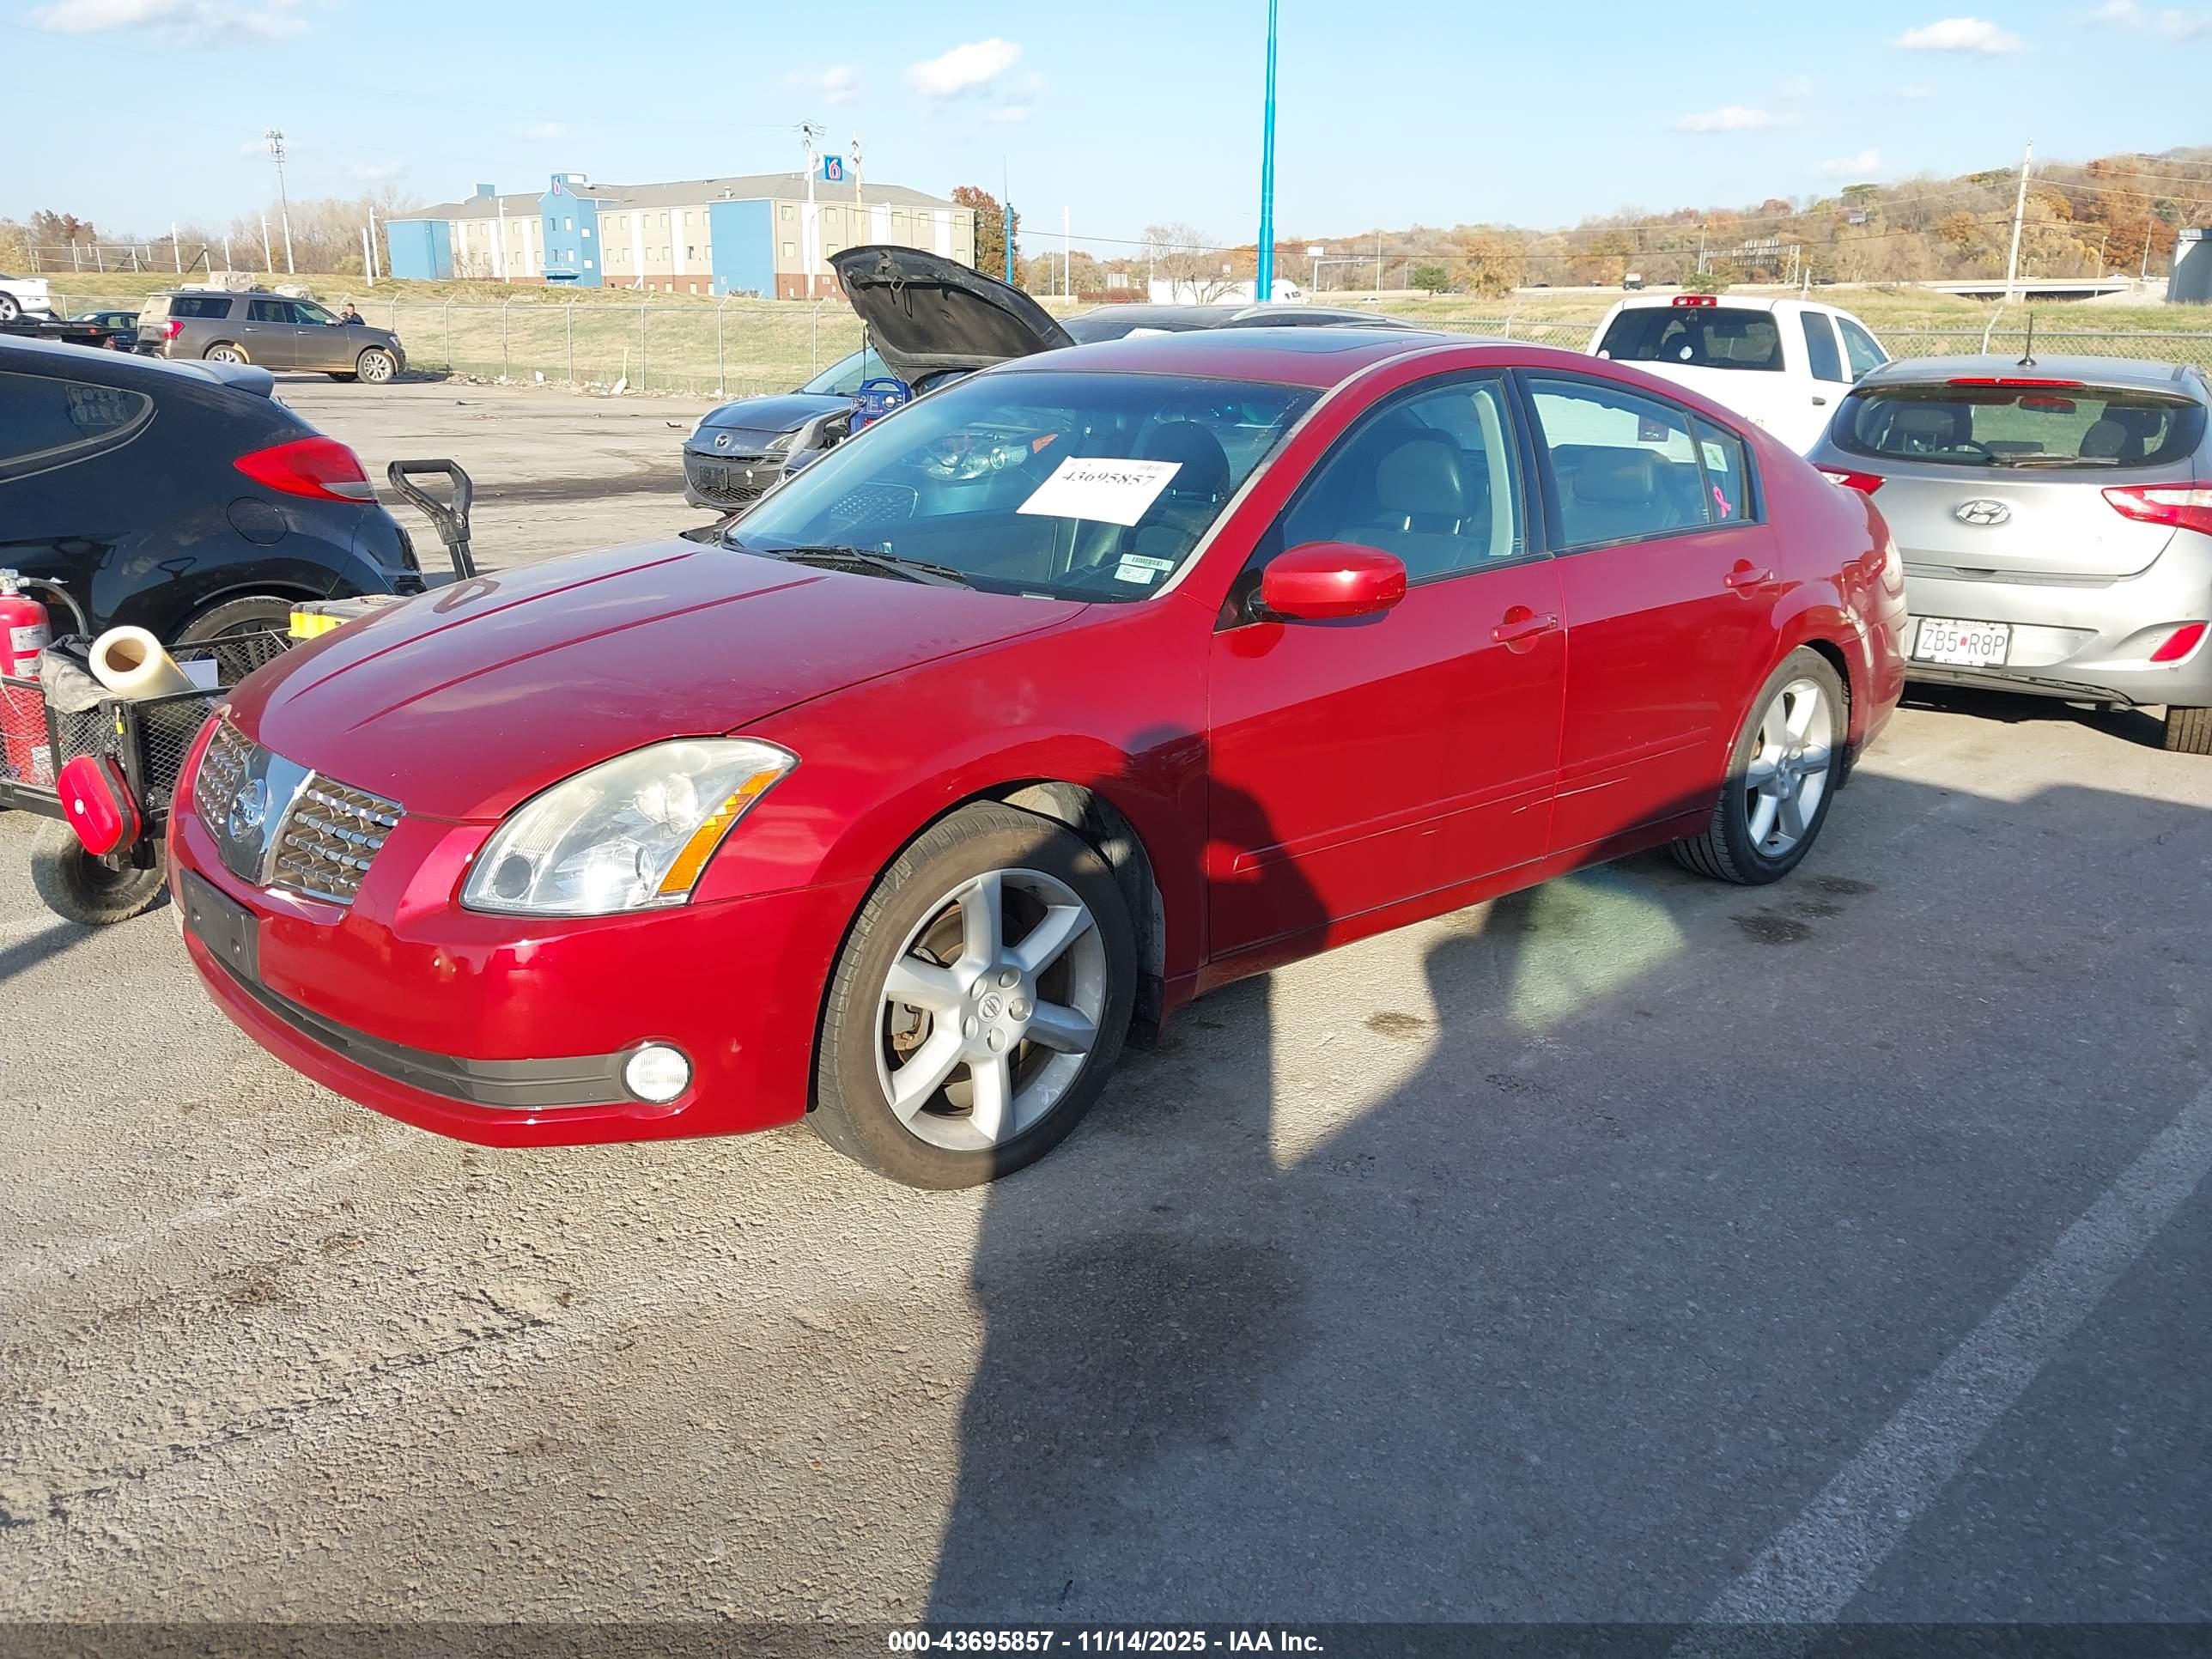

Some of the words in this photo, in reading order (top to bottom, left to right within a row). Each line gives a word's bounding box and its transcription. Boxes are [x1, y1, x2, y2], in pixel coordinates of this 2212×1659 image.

[828, 158, 842, 179] 6
[1061, 471, 1157, 487] 43695857
[1922, 629, 1959, 653] ZB5
[1967, 633, 2006, 656] R8P
